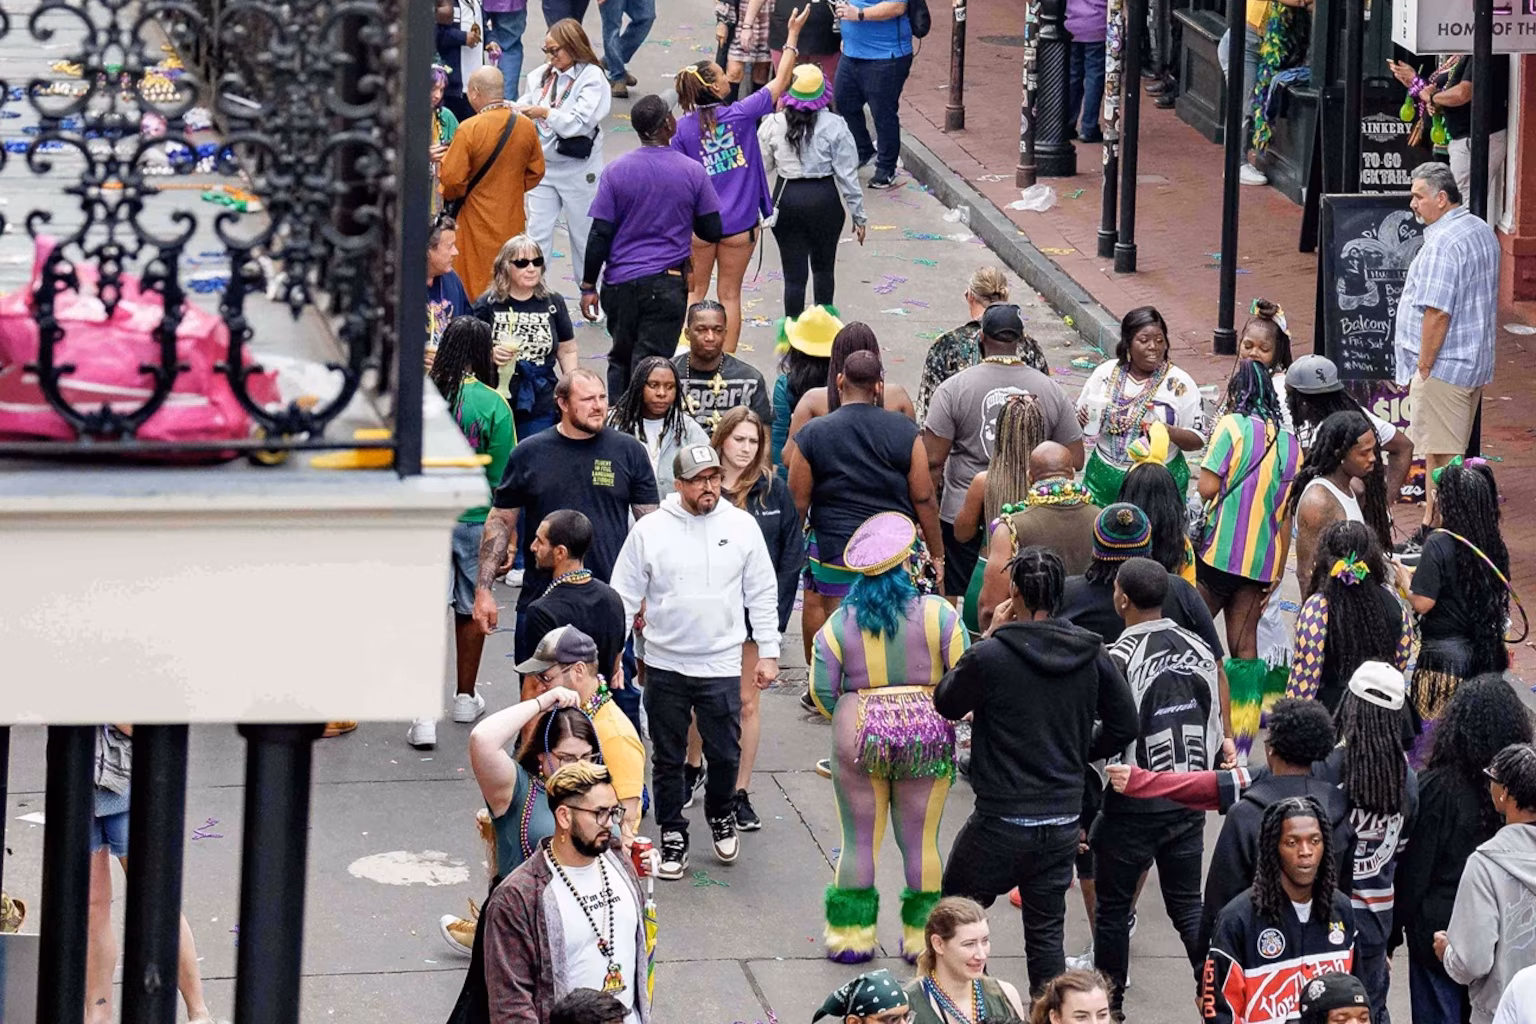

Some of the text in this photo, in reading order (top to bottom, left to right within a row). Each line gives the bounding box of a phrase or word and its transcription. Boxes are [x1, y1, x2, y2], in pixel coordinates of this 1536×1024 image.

[1438, 22, 1476, 36] HOM
[1494, 22, 1513, 36] OF
[1361, 122, 1413, 134] RINKERY
[702, 145, 743, 167] MARDI
[706, 153, 746, 176] GRAS
[494, 311, 550, 323] HUSSY
[1340, 314, 1392, 341] Balcony
[1204, 959, 1217, 1018] DUTCH
